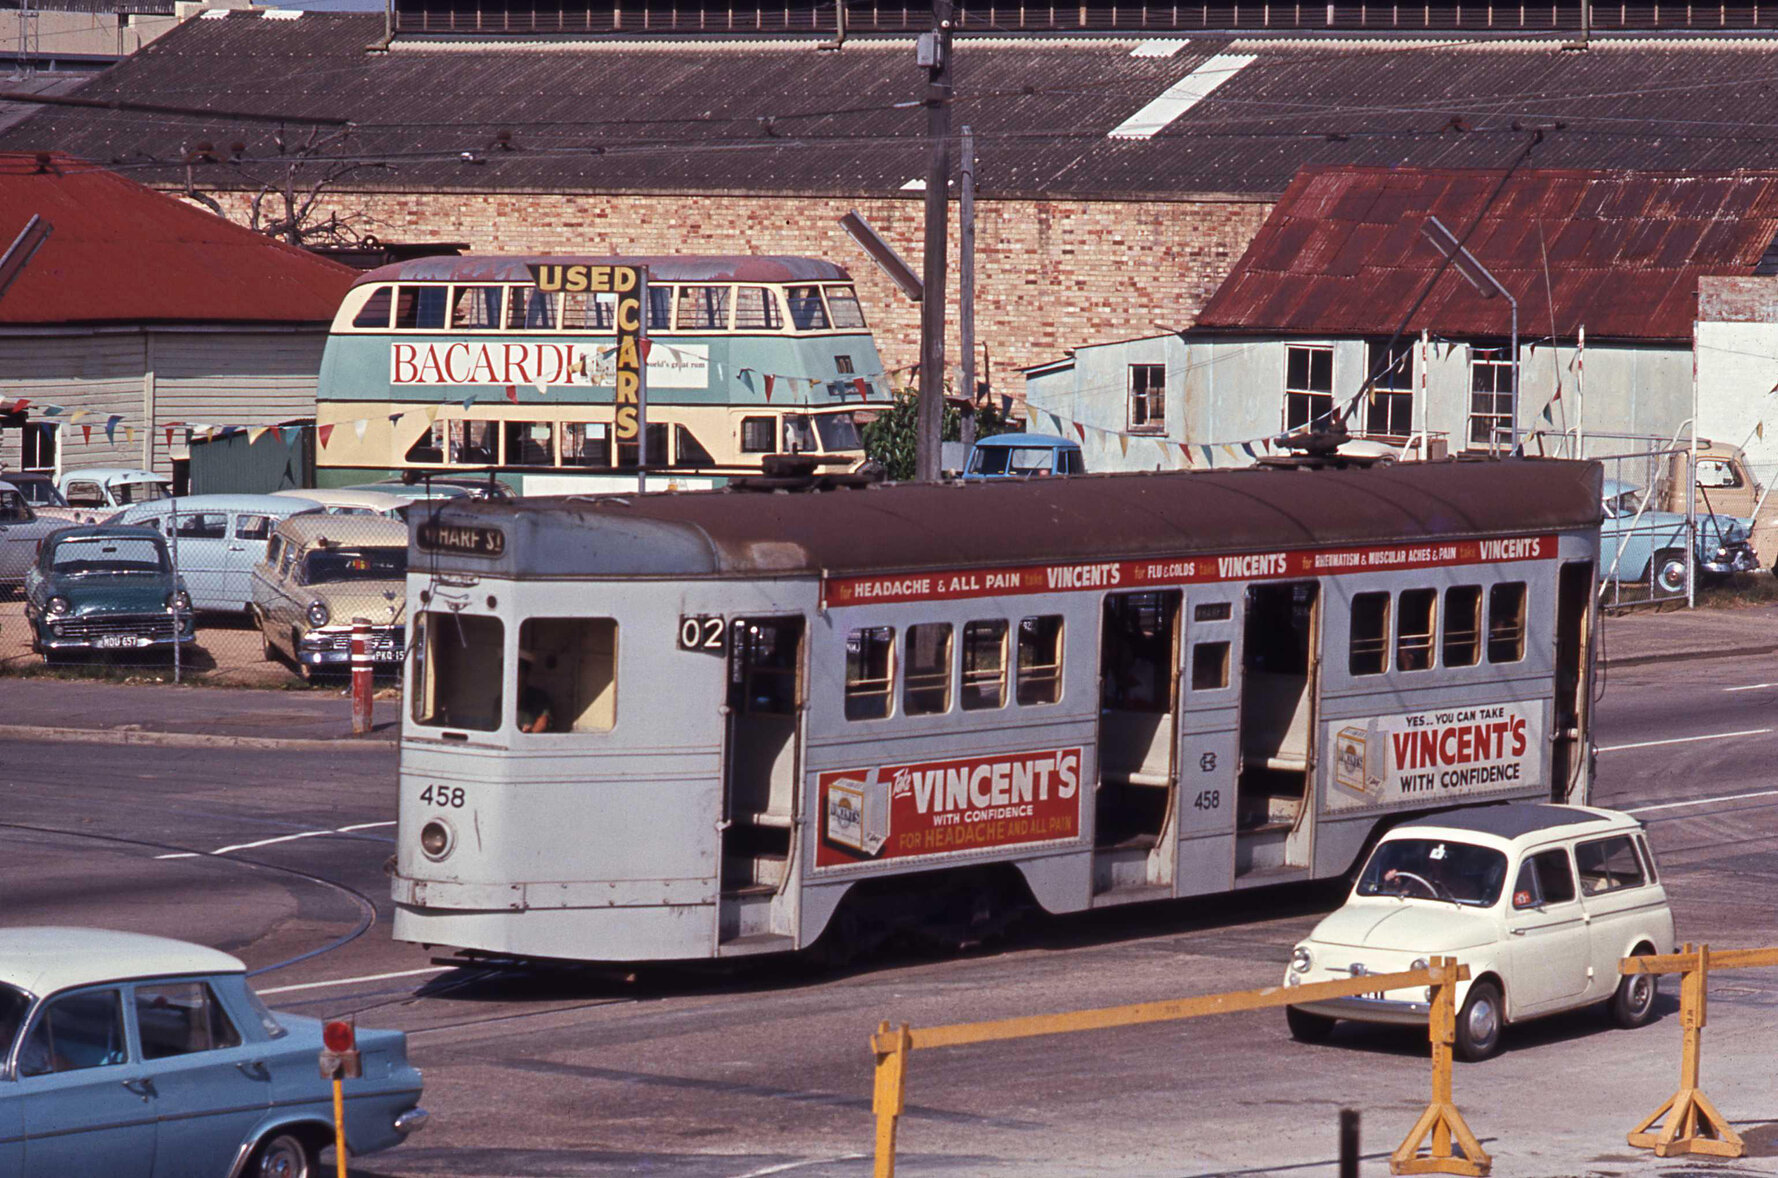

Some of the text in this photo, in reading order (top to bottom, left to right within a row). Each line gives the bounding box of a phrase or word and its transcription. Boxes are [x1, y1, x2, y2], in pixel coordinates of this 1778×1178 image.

[539, 265, 637, 292] USED
[392, 343, 575, 384] BACARDI
[616, 298, 640, 438] CARS
[425, 526, 479, 548] HARF
[854, 579, 930, 597] HEADACHE
[937, 580, 945, 592] &
[949, 575, 979, 591] ALL
[985, 573, 1020, 589] PAIN
[1047, 563, 1120, 588] VINCENT'S
[1218, 553, 1287, 578] VINCENT'S
[1361, 555, 1367, 565] &
[1368, 550, 1406, 565] MUSCULAR
[1408, 548, 1431, 562] ACHES
[1438, 546, 1457, 560] PAIN
[1480, 538, 1540, 560] VINCENT'S
[682, 619, 723, 647] 02
[1435, 713, 1454, 725] YOU
[1456, 710, 1476, 722] CAN
[1480, 707, 1505, 720] TAKE
[1393, 714, 1527, 771] VINCENT'S
[912, 750, 1077, 814] VINCENT'S
[1400, 773, 1435, 793] WITH
[1440, 763, 1520, 789] CONFIDENCE
[420, 784, 465, 808] 458
[1194, 790, 1220, 811] 458
[933, 805, 1034, 826] WITH CONFIDENCE
[900, 832, 921, 849] FOR
[925, 821, 1005, 849] HEADACHE
[1007, 820, 1028, 837] AND
[1030, 818, 1048, 833] ALL
[1049, 816, 1073, 832] PAIN
